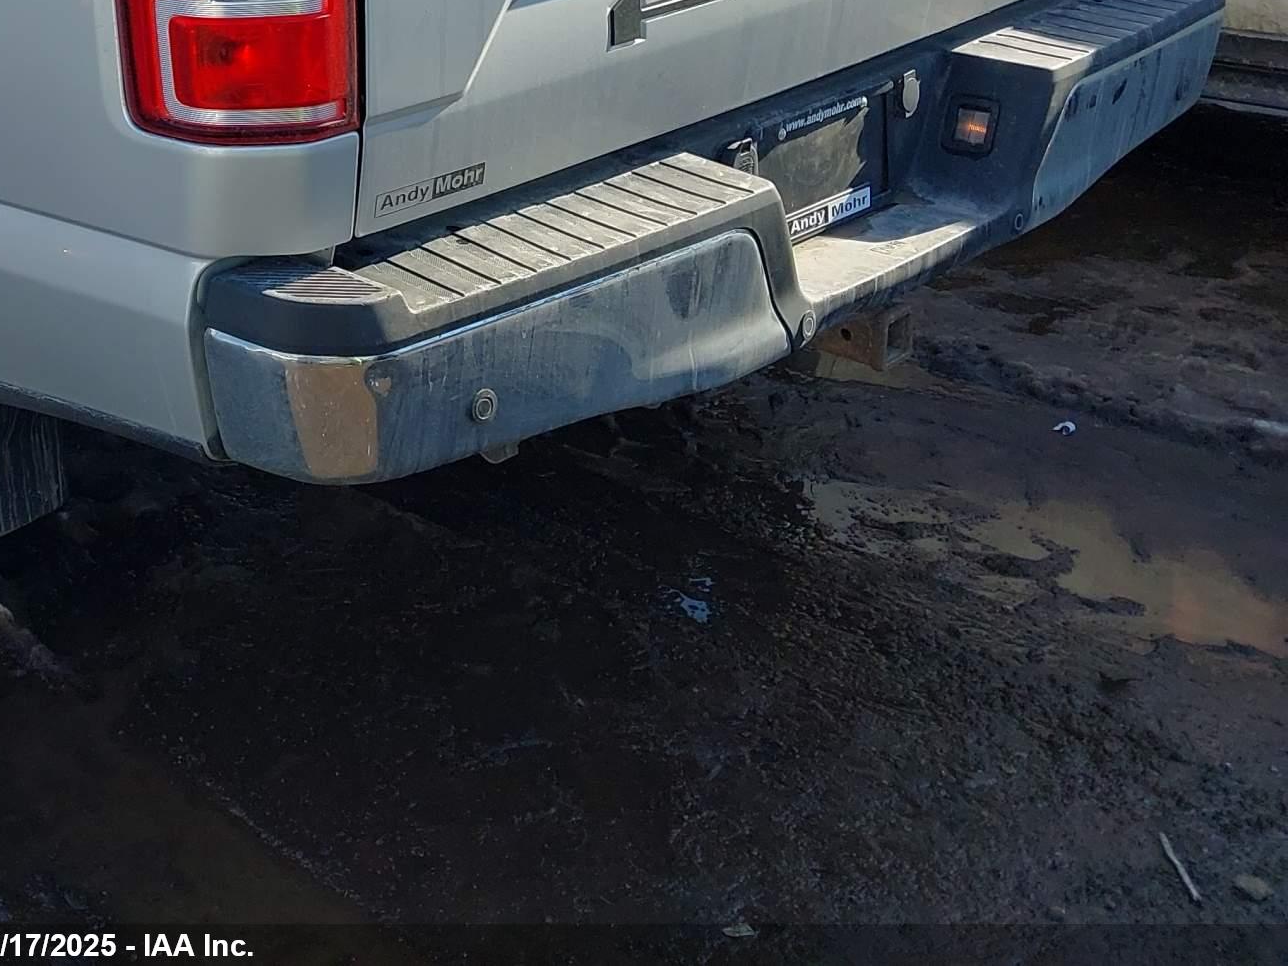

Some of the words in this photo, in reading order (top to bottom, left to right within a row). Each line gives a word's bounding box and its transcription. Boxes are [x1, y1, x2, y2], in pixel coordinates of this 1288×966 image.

[786, 97, 862, 132] www.andymohr.com
[380, 185, 429, 211] Andy
[435, 167, 483, 194] Mohr
[790, 209, 825, 234] Andy
[831, 194, 868, 217] Mohr
